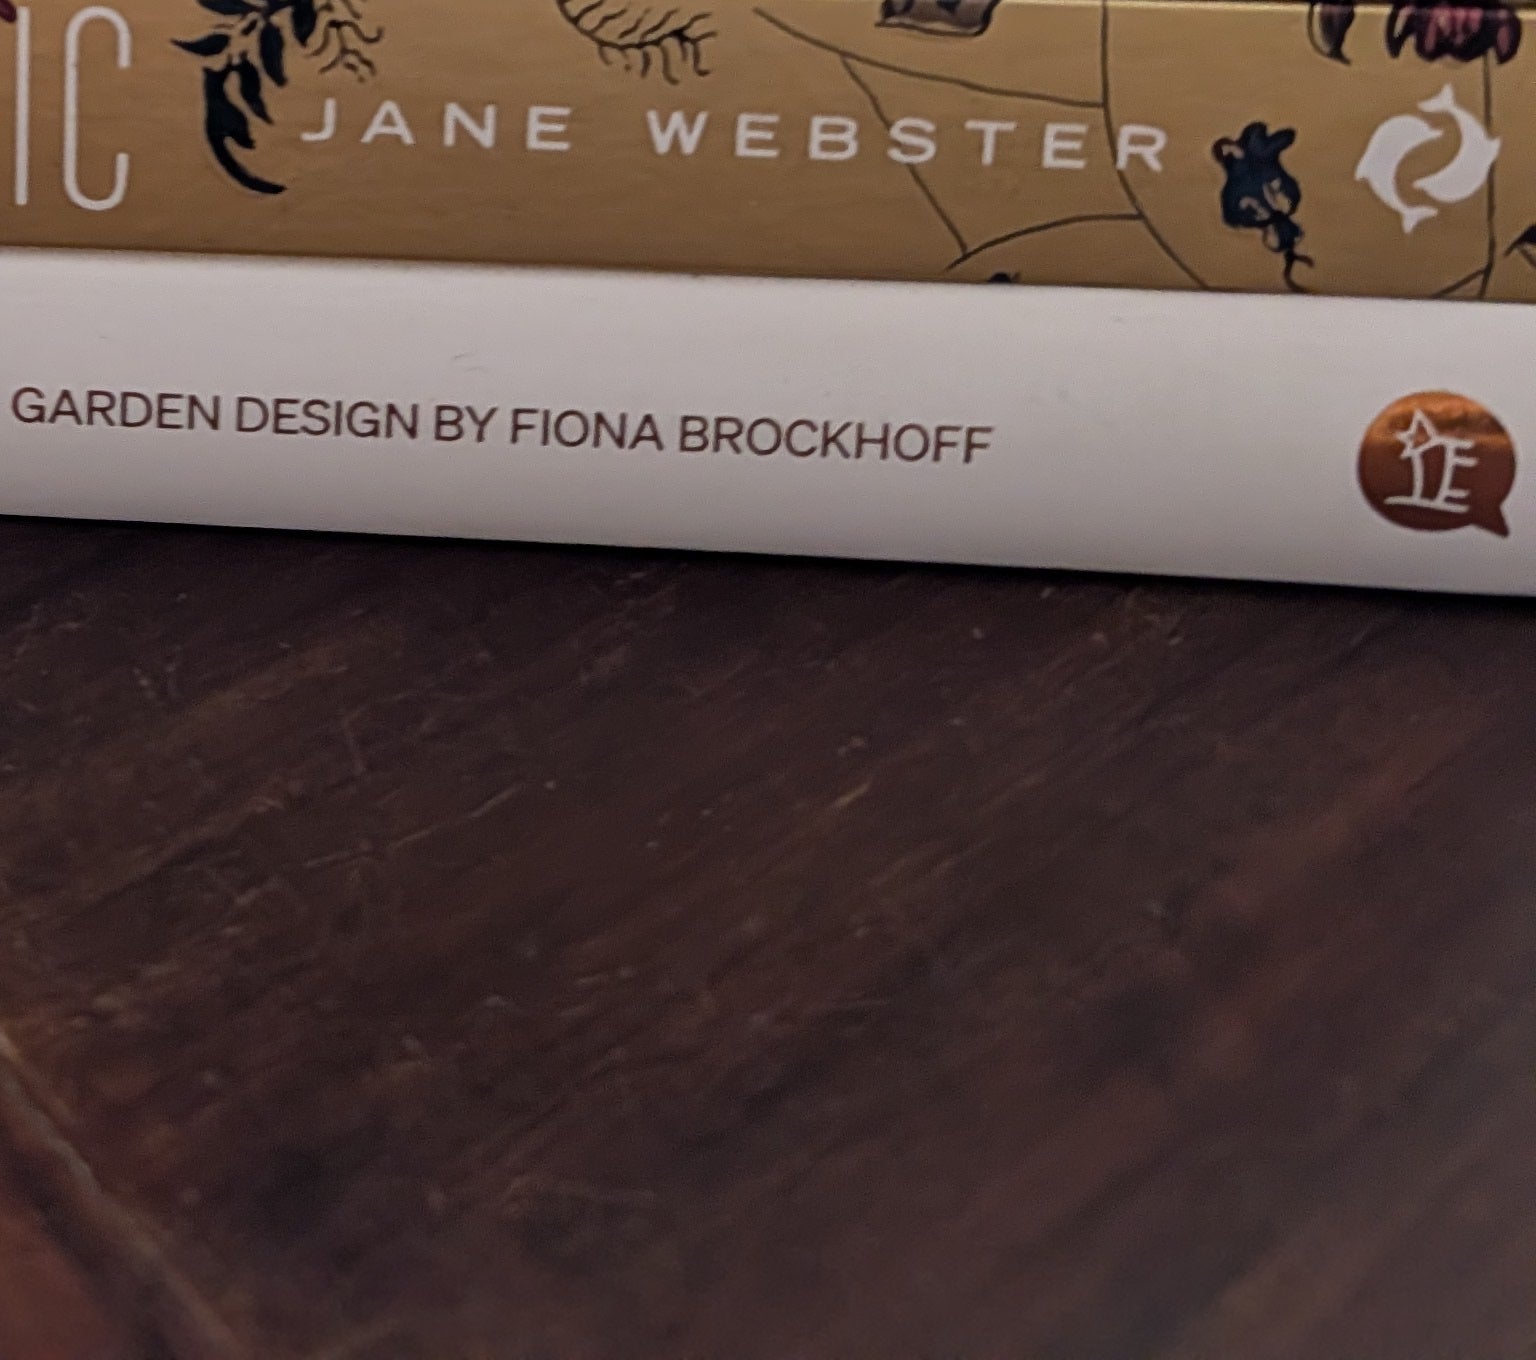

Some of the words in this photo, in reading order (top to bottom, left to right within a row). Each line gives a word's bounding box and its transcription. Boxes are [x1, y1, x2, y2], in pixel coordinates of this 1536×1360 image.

[300, 98, 574, 152] JANE
[646, 110, 1168, 172] WEBSTER
[10, 386, 220, 432] GARDEN
[235, 393, 419, 441] DESIGN
[434, 404, 498, 443] BY
[510, 408, 664, 452] FIONA
[678, 415, 994, 465] BROCKHOFF
